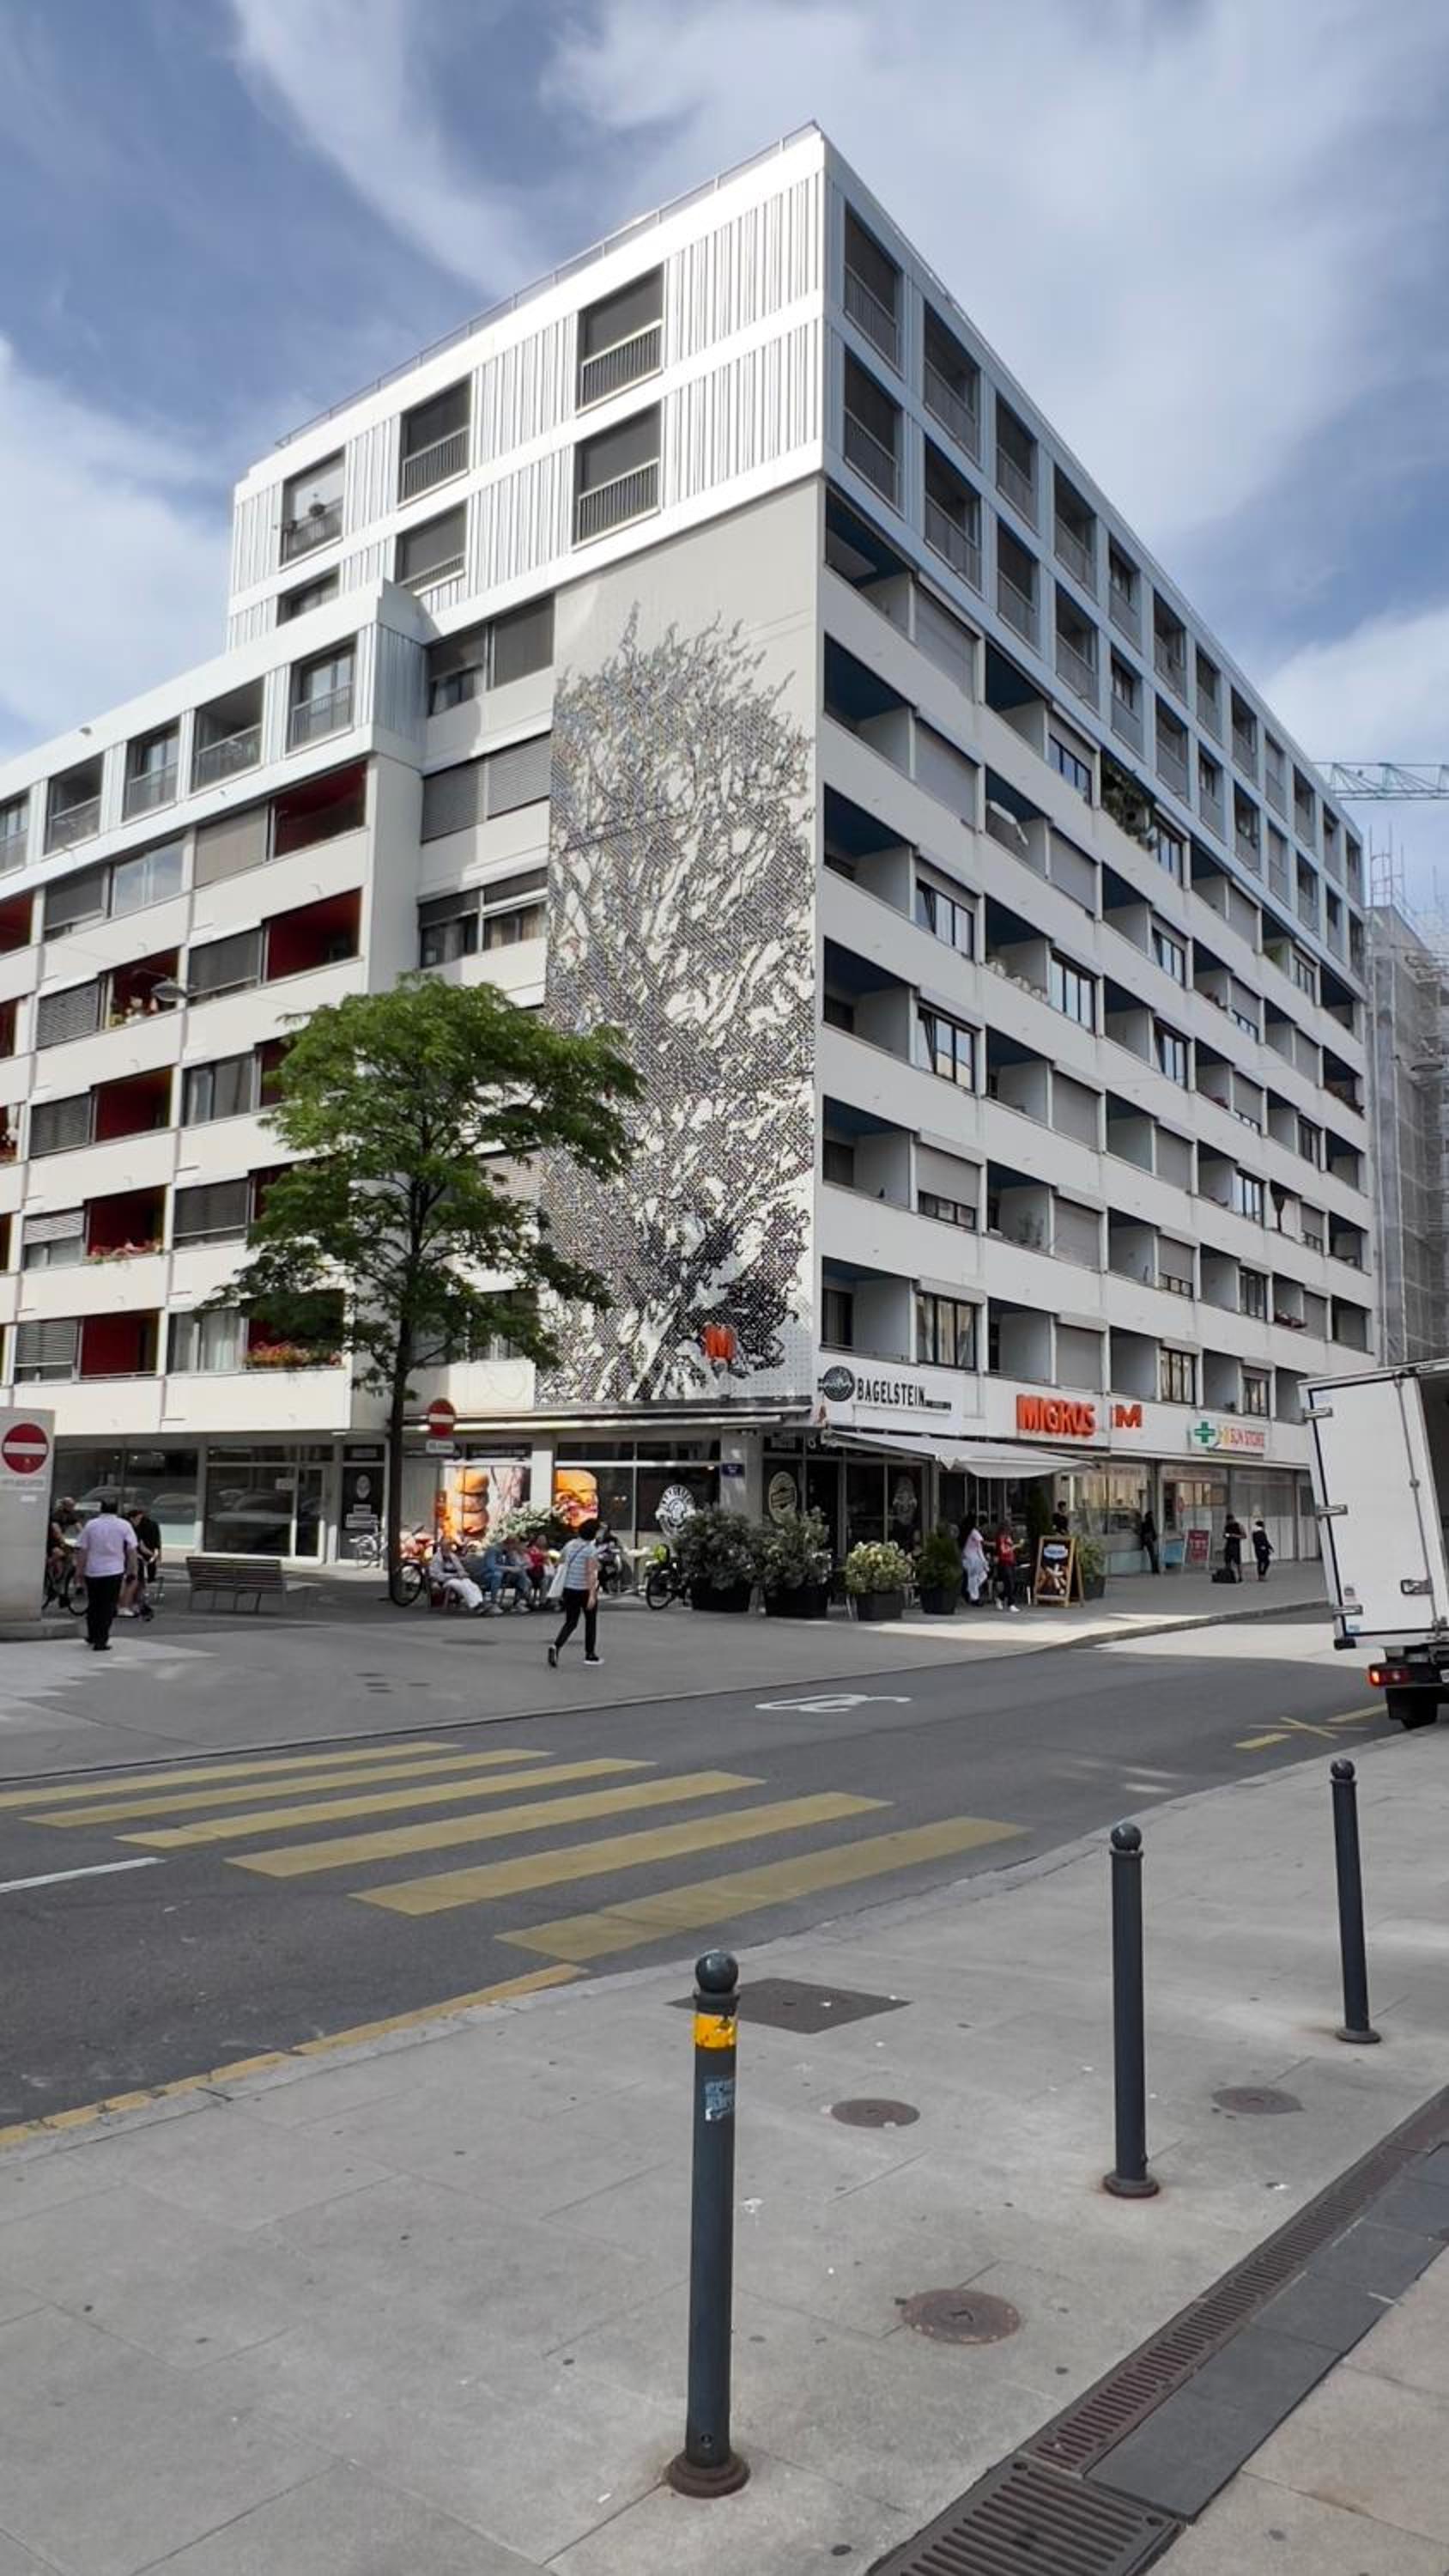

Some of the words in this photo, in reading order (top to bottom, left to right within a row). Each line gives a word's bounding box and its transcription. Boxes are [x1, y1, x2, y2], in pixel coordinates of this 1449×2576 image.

[857, 1376, 925, 1407] BAGELSTEIN
[1016, 1394, 1095, 1436] MIGROS
[1114, 1404, 1143, 1427] M
